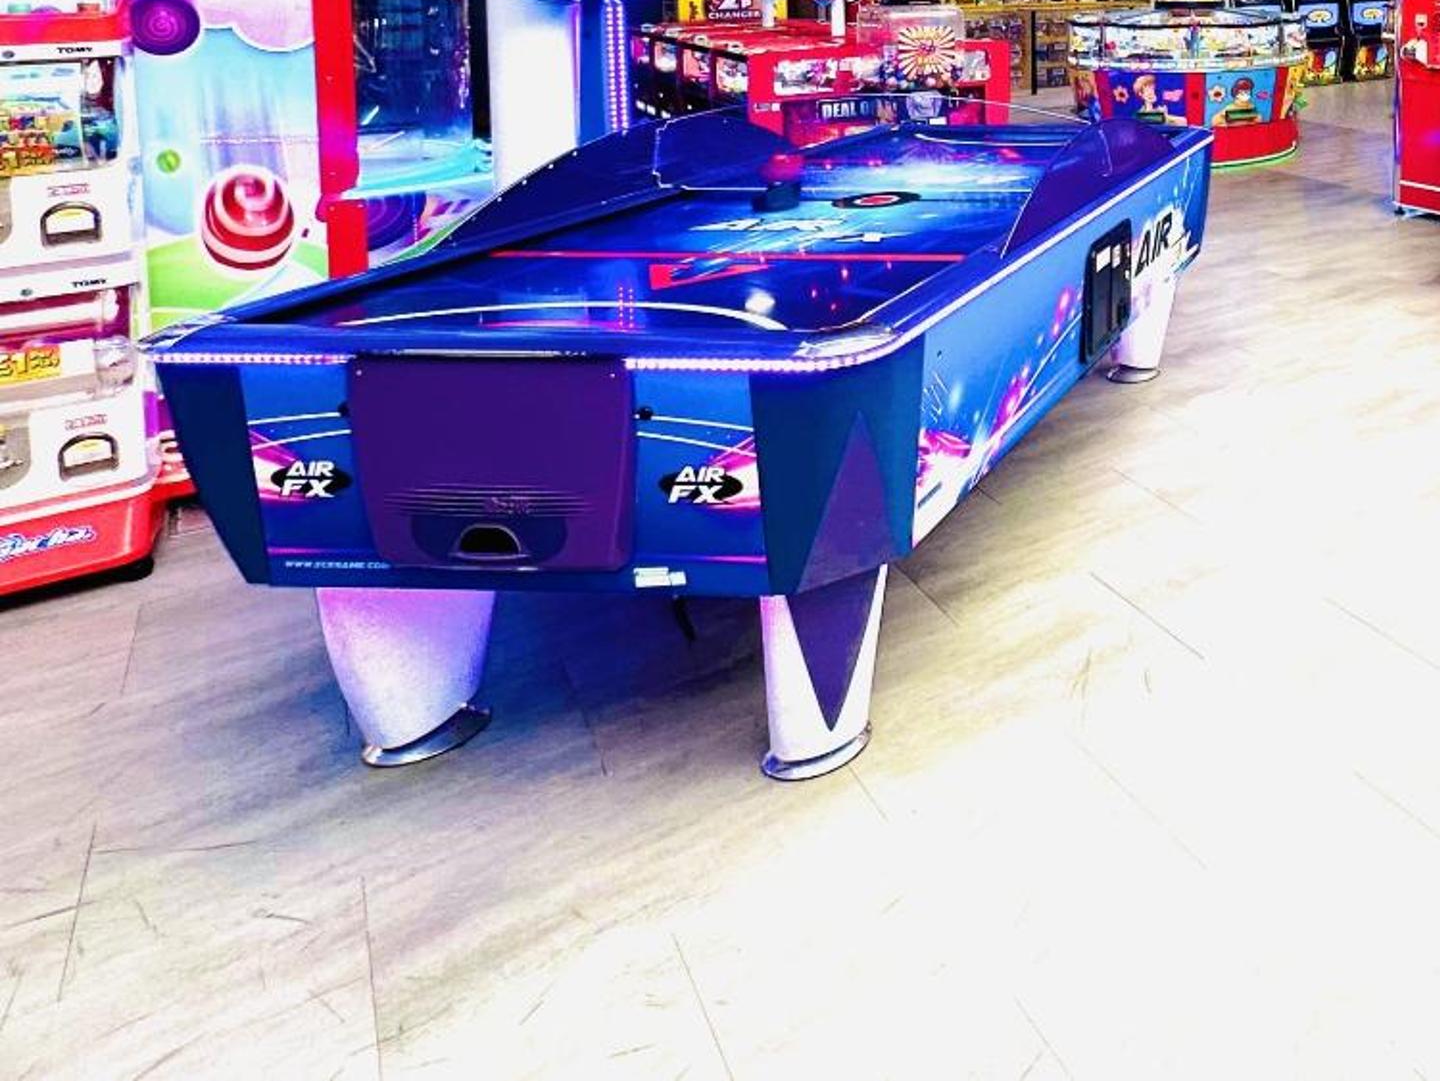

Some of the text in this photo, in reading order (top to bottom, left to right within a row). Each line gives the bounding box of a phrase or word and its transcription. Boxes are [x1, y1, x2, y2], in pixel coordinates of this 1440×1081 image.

[56, 46, 93, 54] TOMY
[821, 102, 856, 119] DEAL
[1135, 211, 1173, 278] AIR
[286, 460, 335, 477] AIR
[676, 466, 725, 483] AIR
[281, 478, 336, 498] FX
[668, 484, 725, 504] FX
